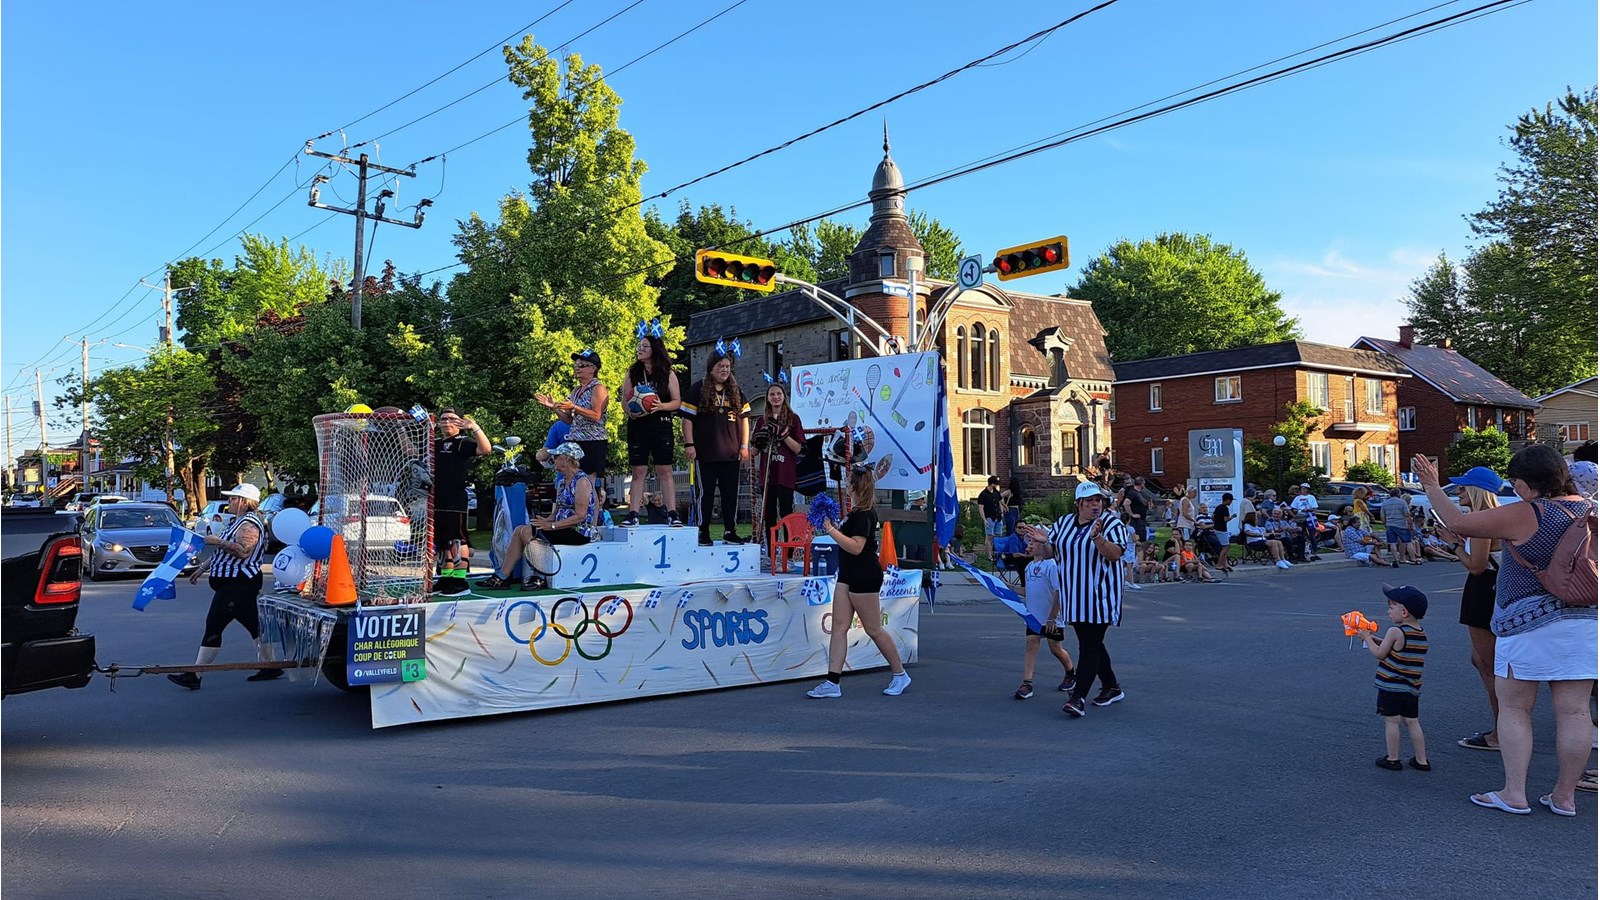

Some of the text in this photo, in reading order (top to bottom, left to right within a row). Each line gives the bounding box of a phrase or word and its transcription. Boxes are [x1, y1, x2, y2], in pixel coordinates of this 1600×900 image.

[653, 534, 671, 569] 1
[724, 551, 740, 573] 3
[581, 553, 601, 583] 2
[355, 613, 419, 639] VOTEZ!
[681, 607, 769, 650] SPORTS
[354, 638, 419, 651] CHAR ALLÉGORIQUE
[354, 652, 372, 662] COUP
[373, 651, 383, 661] DE
[405, 663, 419, 678] #3
